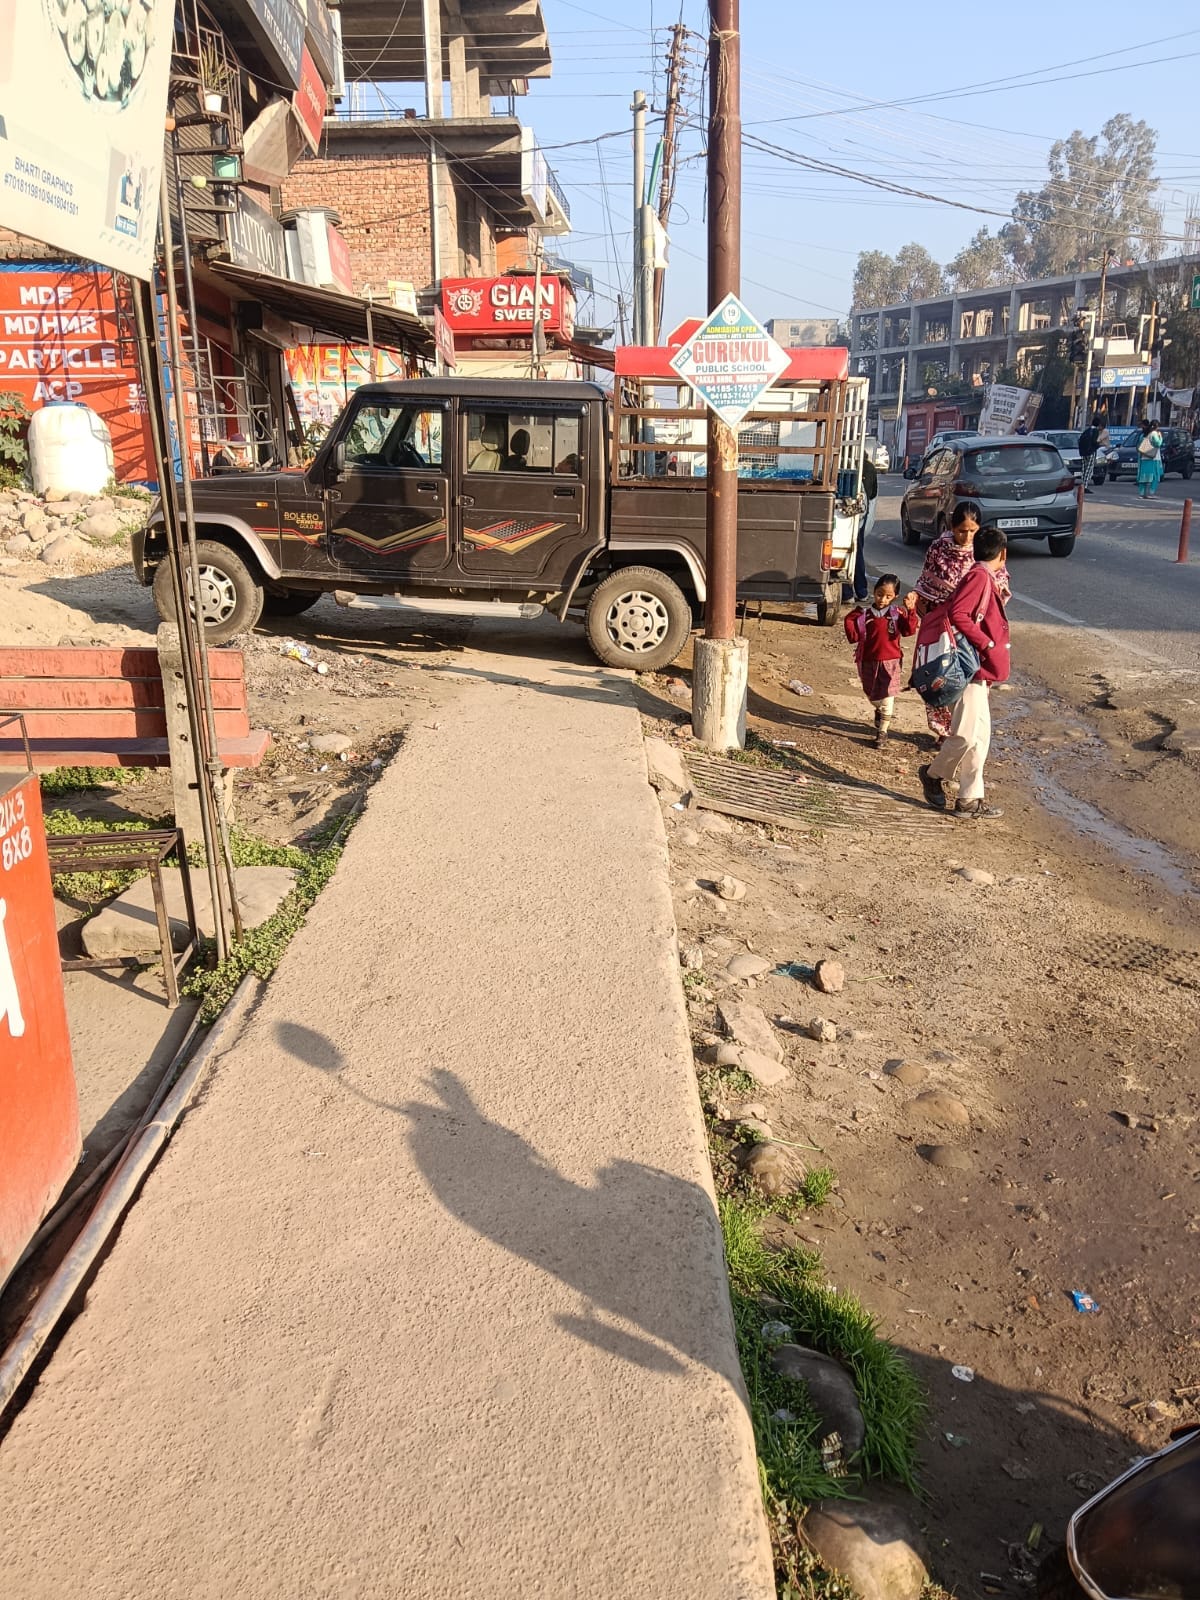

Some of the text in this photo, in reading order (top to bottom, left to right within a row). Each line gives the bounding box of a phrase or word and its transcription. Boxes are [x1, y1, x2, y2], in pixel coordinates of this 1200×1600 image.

[15, 156, 73, 196] BHARTI GRAPHICS
[20, 286, 73, 305] MDF
[491, 283, 555, 307] GIAN
[4, 315, 98, 335] MDHMR
[741, 325, 757, 333] OPEN
[692, 340, 772, 363] GURUKUL
[695, 363, 767, 373] PUBLIC SCHOOL
[33, 381, 83, 401] ACP
[284, 512, 319, 520] BOLERO
[2, 825, 33, 871] 8X8
